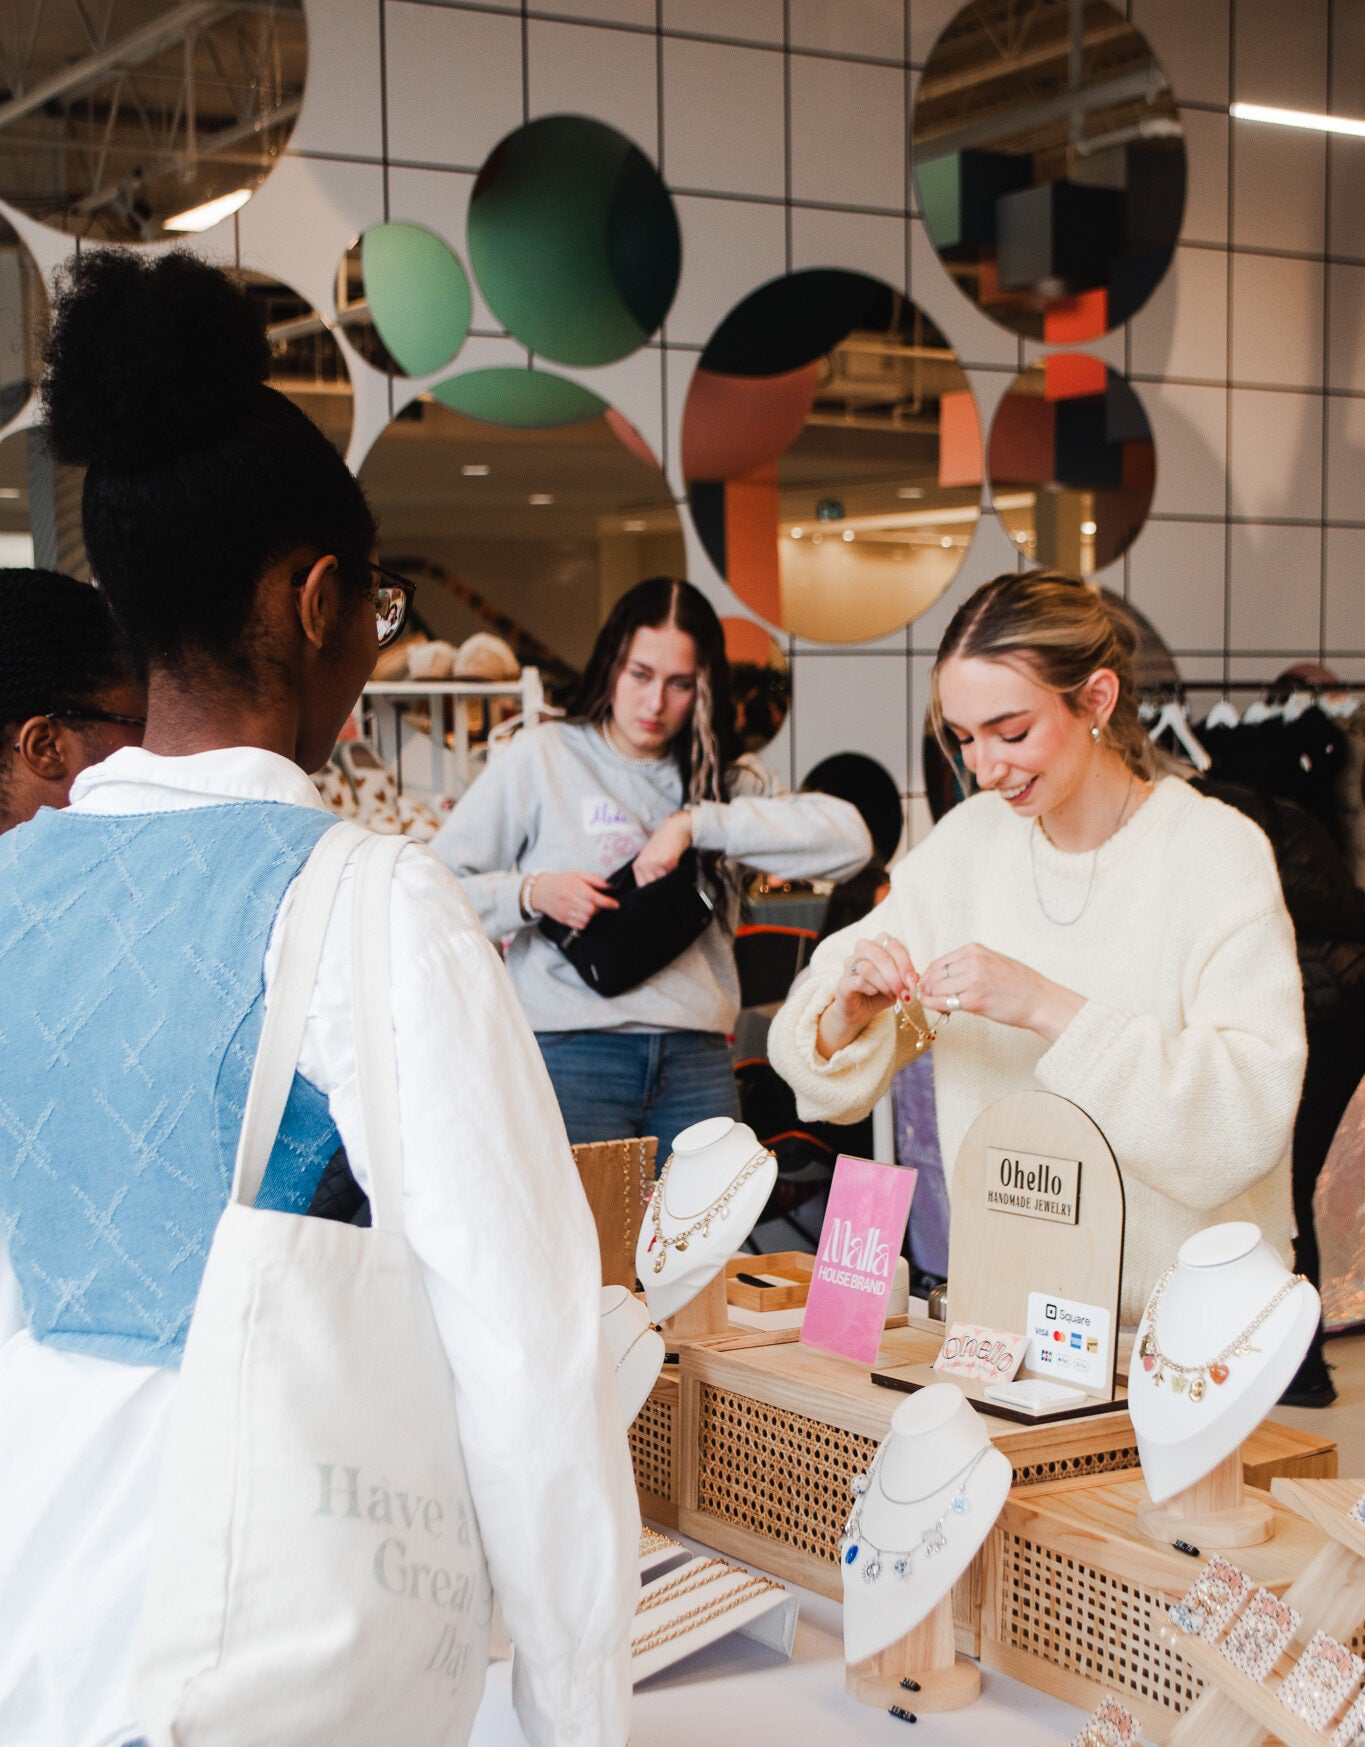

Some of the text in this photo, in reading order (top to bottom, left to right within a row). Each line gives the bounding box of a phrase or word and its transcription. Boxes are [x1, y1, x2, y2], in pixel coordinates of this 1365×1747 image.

[1000, 1158, 1062, 1196] Ohello
[987, 1190, 1073, 1217] HANDMADE JEWELRY
[822, 1217, 890, 1278] Malla
[817, 1264, 887, 1296] HOUSE BRAND
[1034, 1326, 1050, 1337] VISA
[1059, 1309, 1092, 1327] Square
[313, 1463, 471, 1549] Have a
